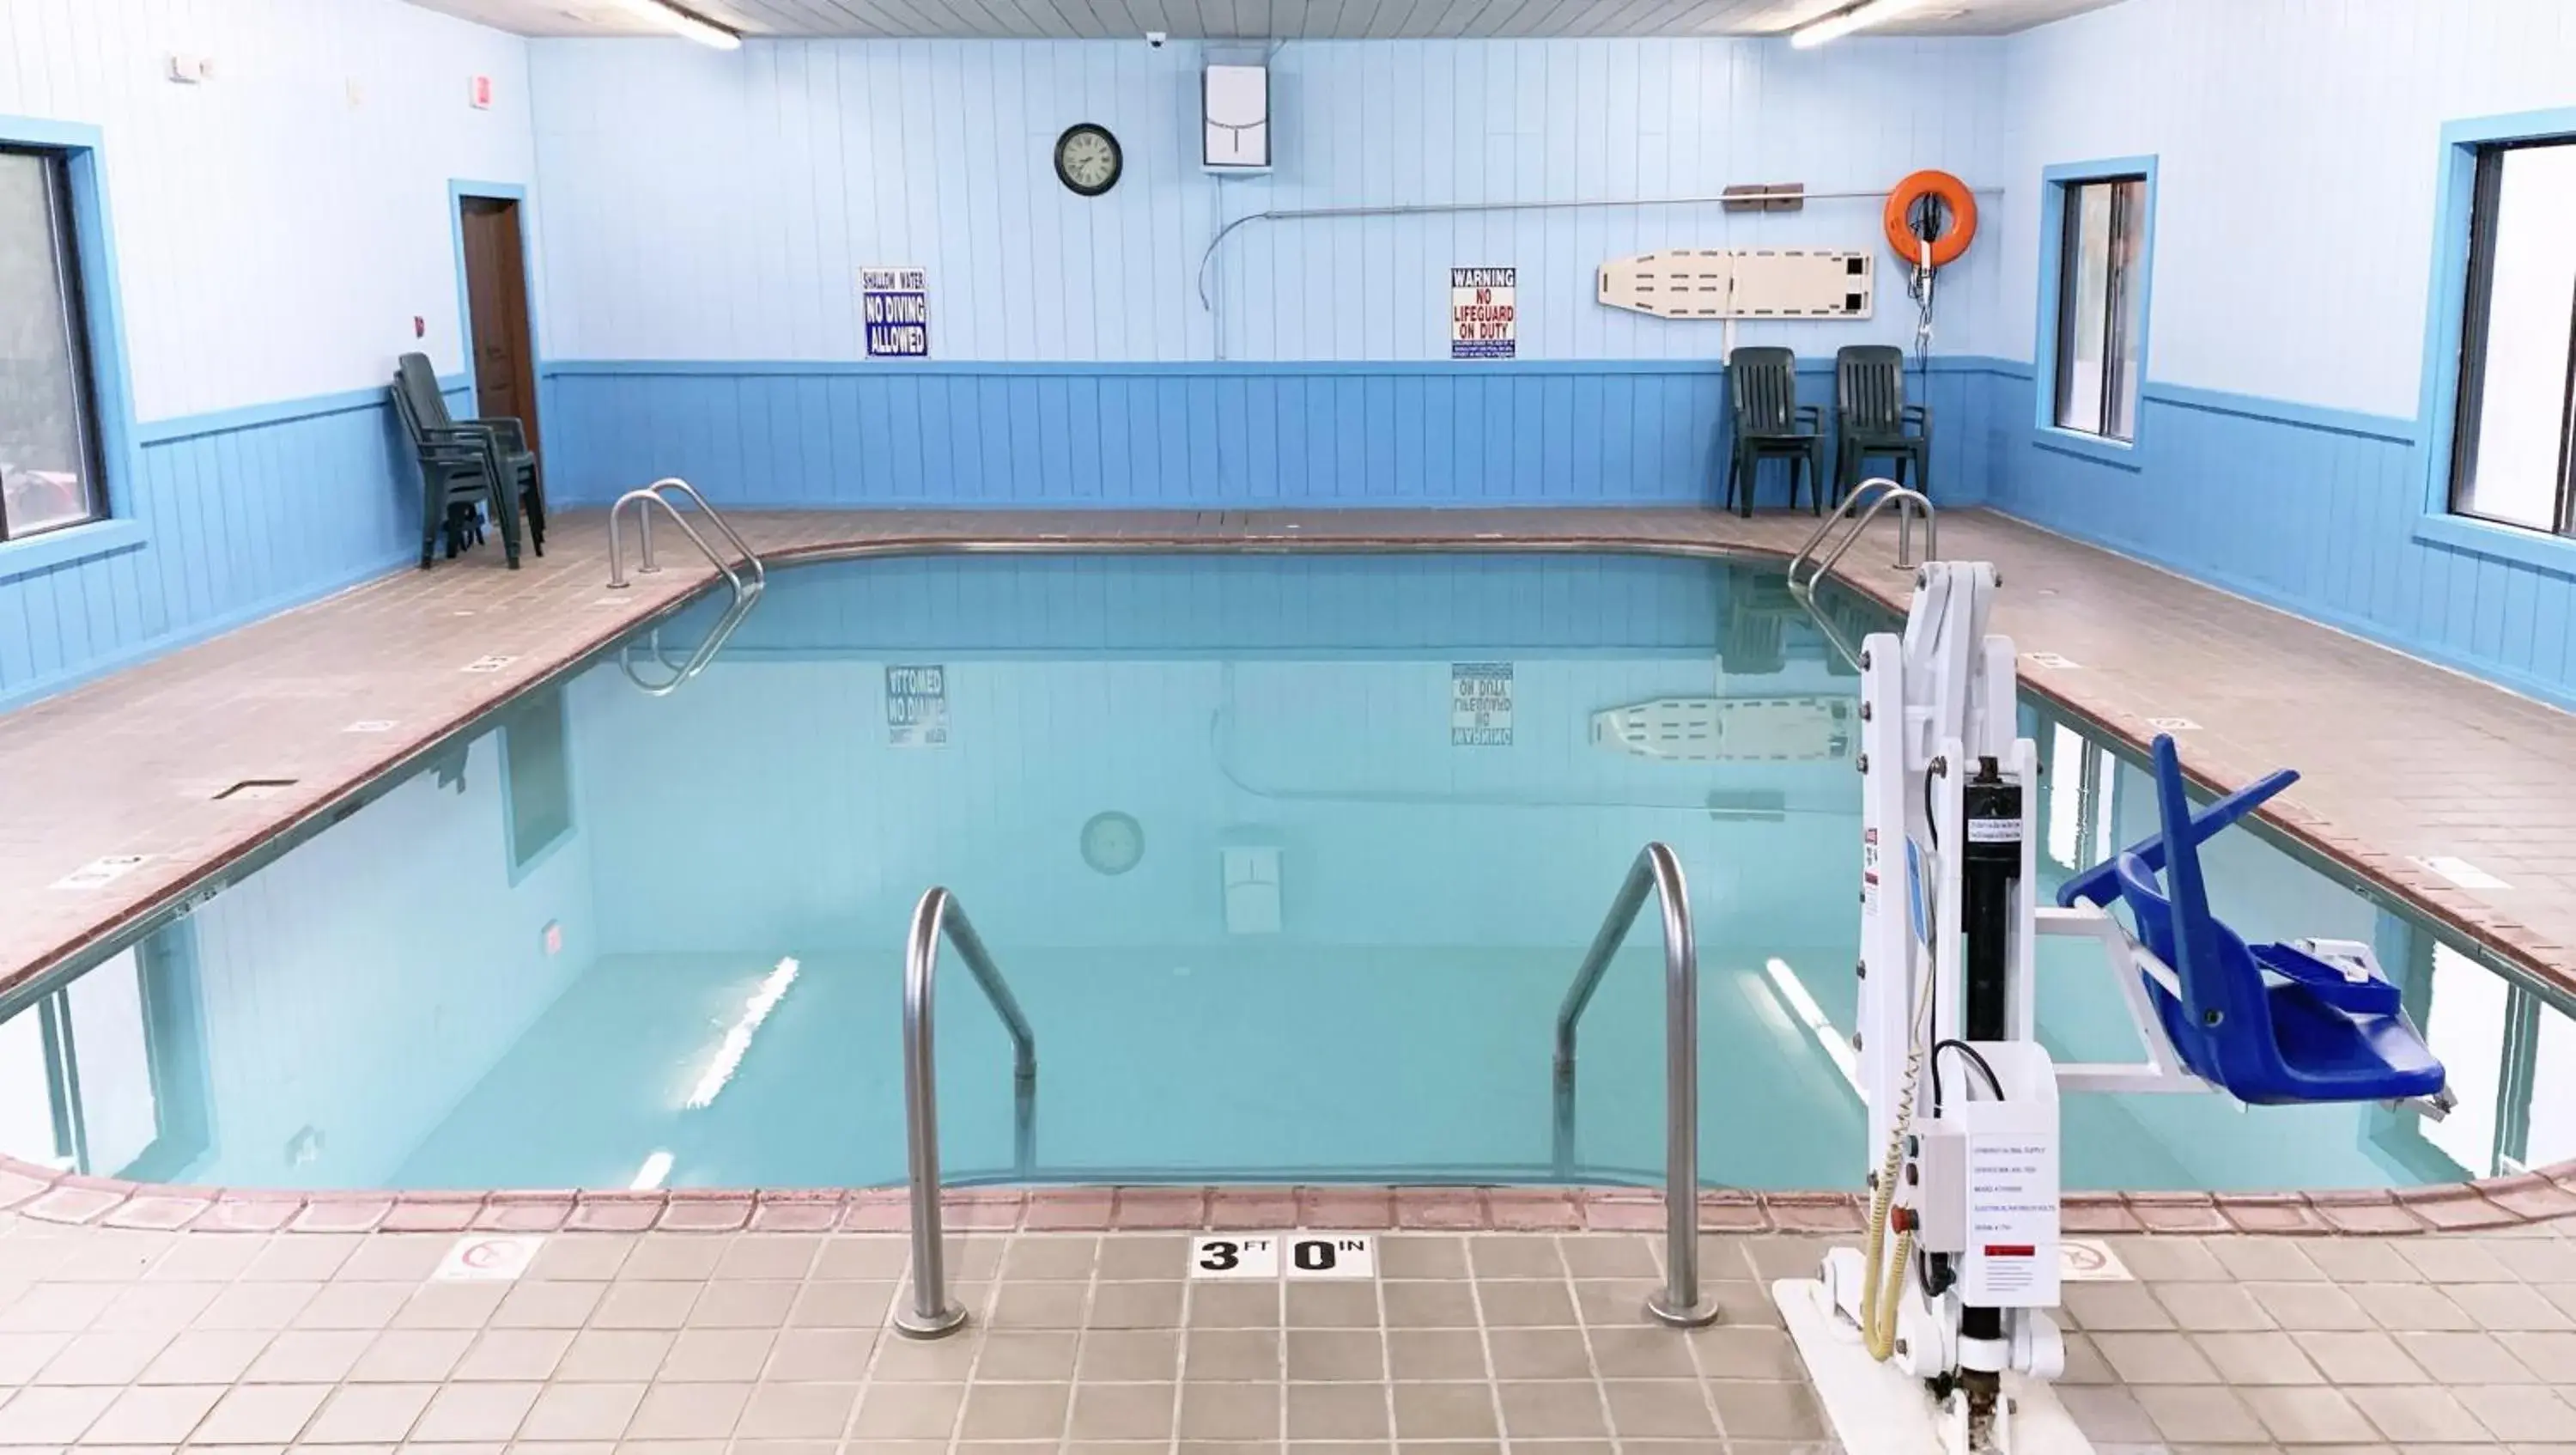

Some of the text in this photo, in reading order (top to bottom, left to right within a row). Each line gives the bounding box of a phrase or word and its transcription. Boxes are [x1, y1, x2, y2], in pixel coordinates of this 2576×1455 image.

[1454, 269, 1514, 287] WARNING
[1476, 288, 1492, 304] NO
[866, 295, 926, 324] NO DIVING
[1454, 305, 1514, 322] LIFEGUARD
[872, 326, 925, 354] ALLOWED
[1459, 323, 1509, 339] ON DUTY
[1200, 1240, 1365, 1270] 3 FT 0 IN
